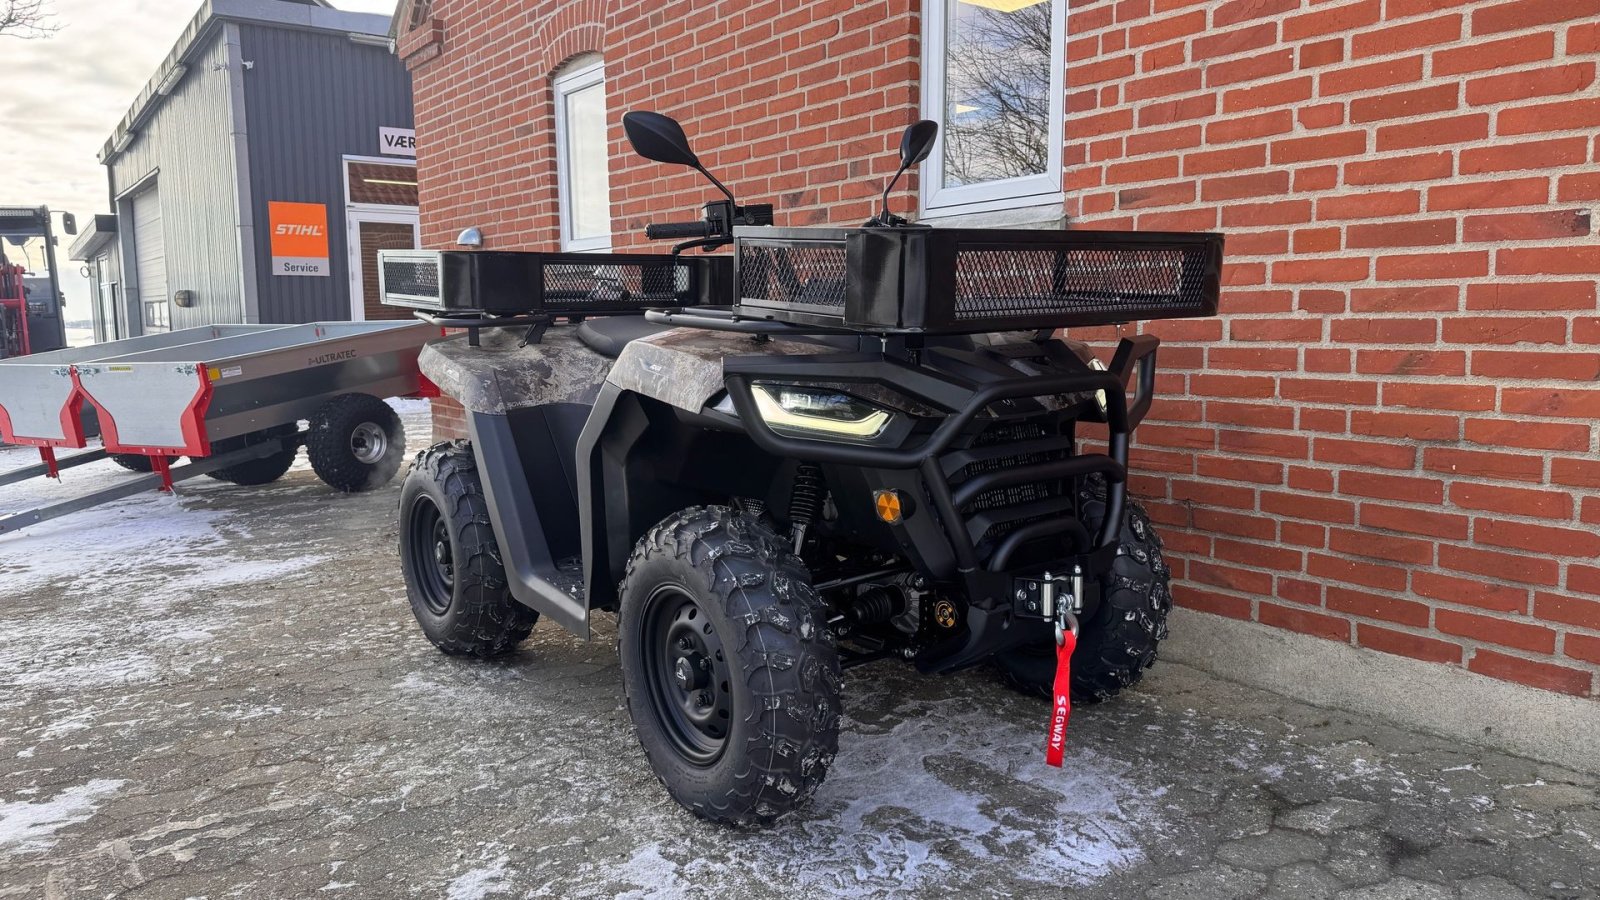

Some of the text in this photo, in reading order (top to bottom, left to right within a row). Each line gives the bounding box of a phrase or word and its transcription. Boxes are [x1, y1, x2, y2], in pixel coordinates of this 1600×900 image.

[275, 224, 322, 236] STIHL
[284, 262, 319, 273] Service
[1051, 696, 1067, 750] SEGWAY
